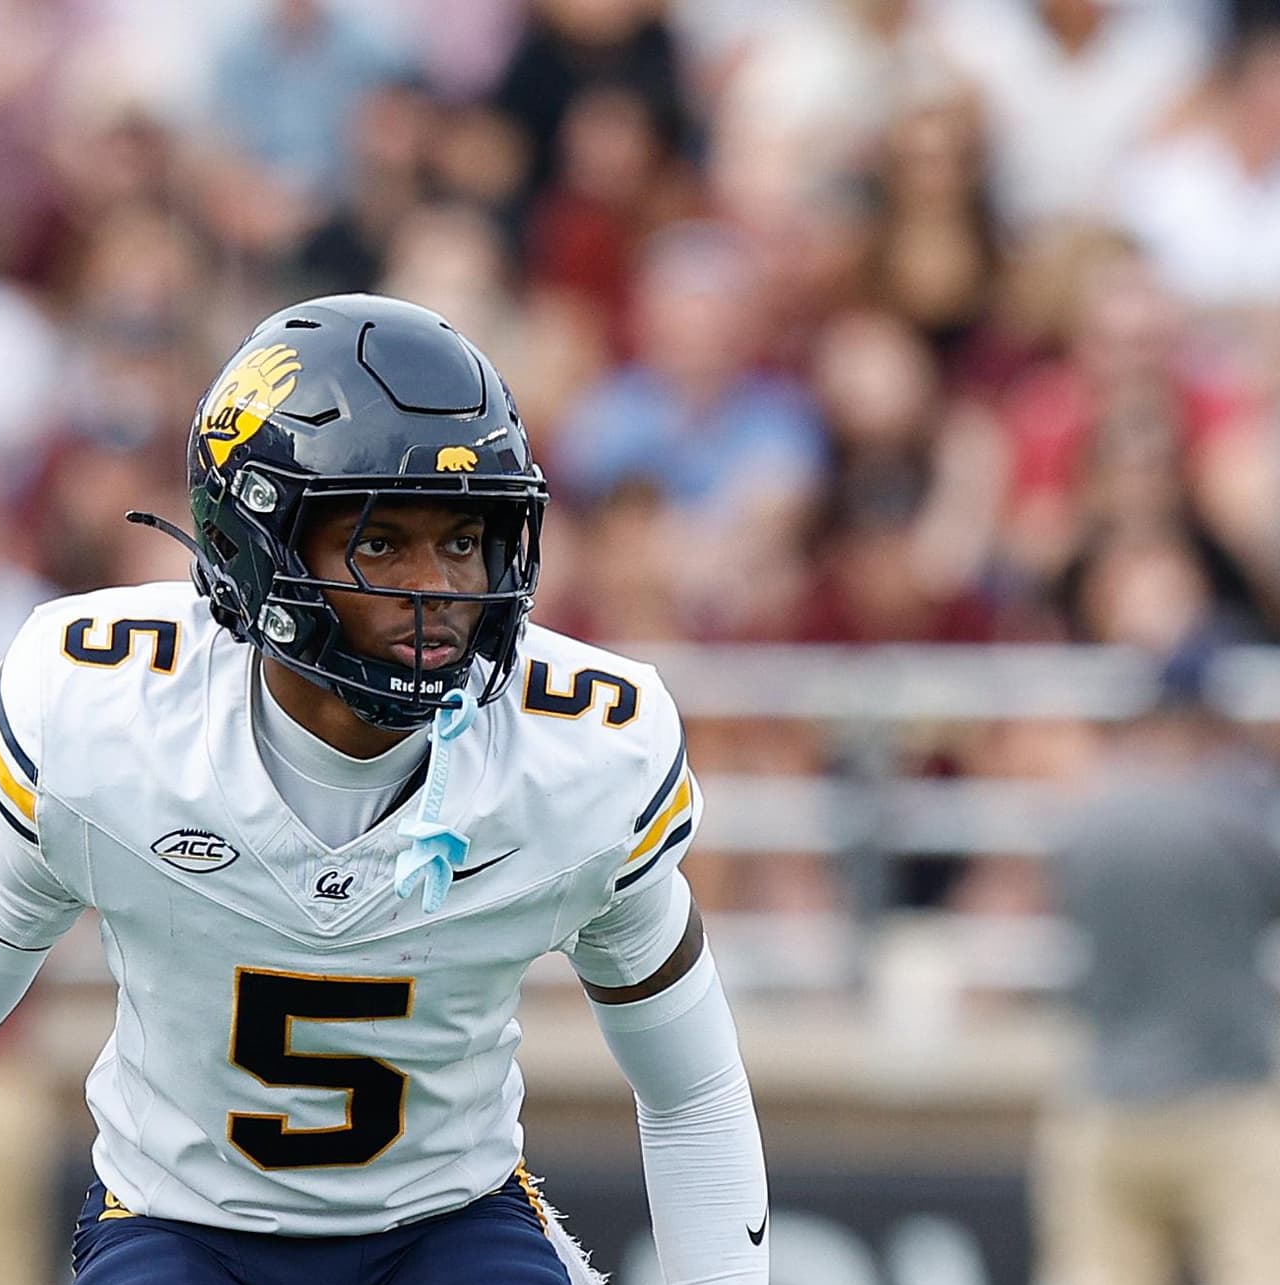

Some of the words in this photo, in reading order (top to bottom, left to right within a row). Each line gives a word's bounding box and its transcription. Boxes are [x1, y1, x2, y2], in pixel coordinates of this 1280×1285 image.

[61, 616, 180, 676] 5
[522, 657, 640, 729] 5
[162, 841, 225, 858] ACC
[314, 871, 354, 899] Cal
[226, 966, 415, 1170] 5
